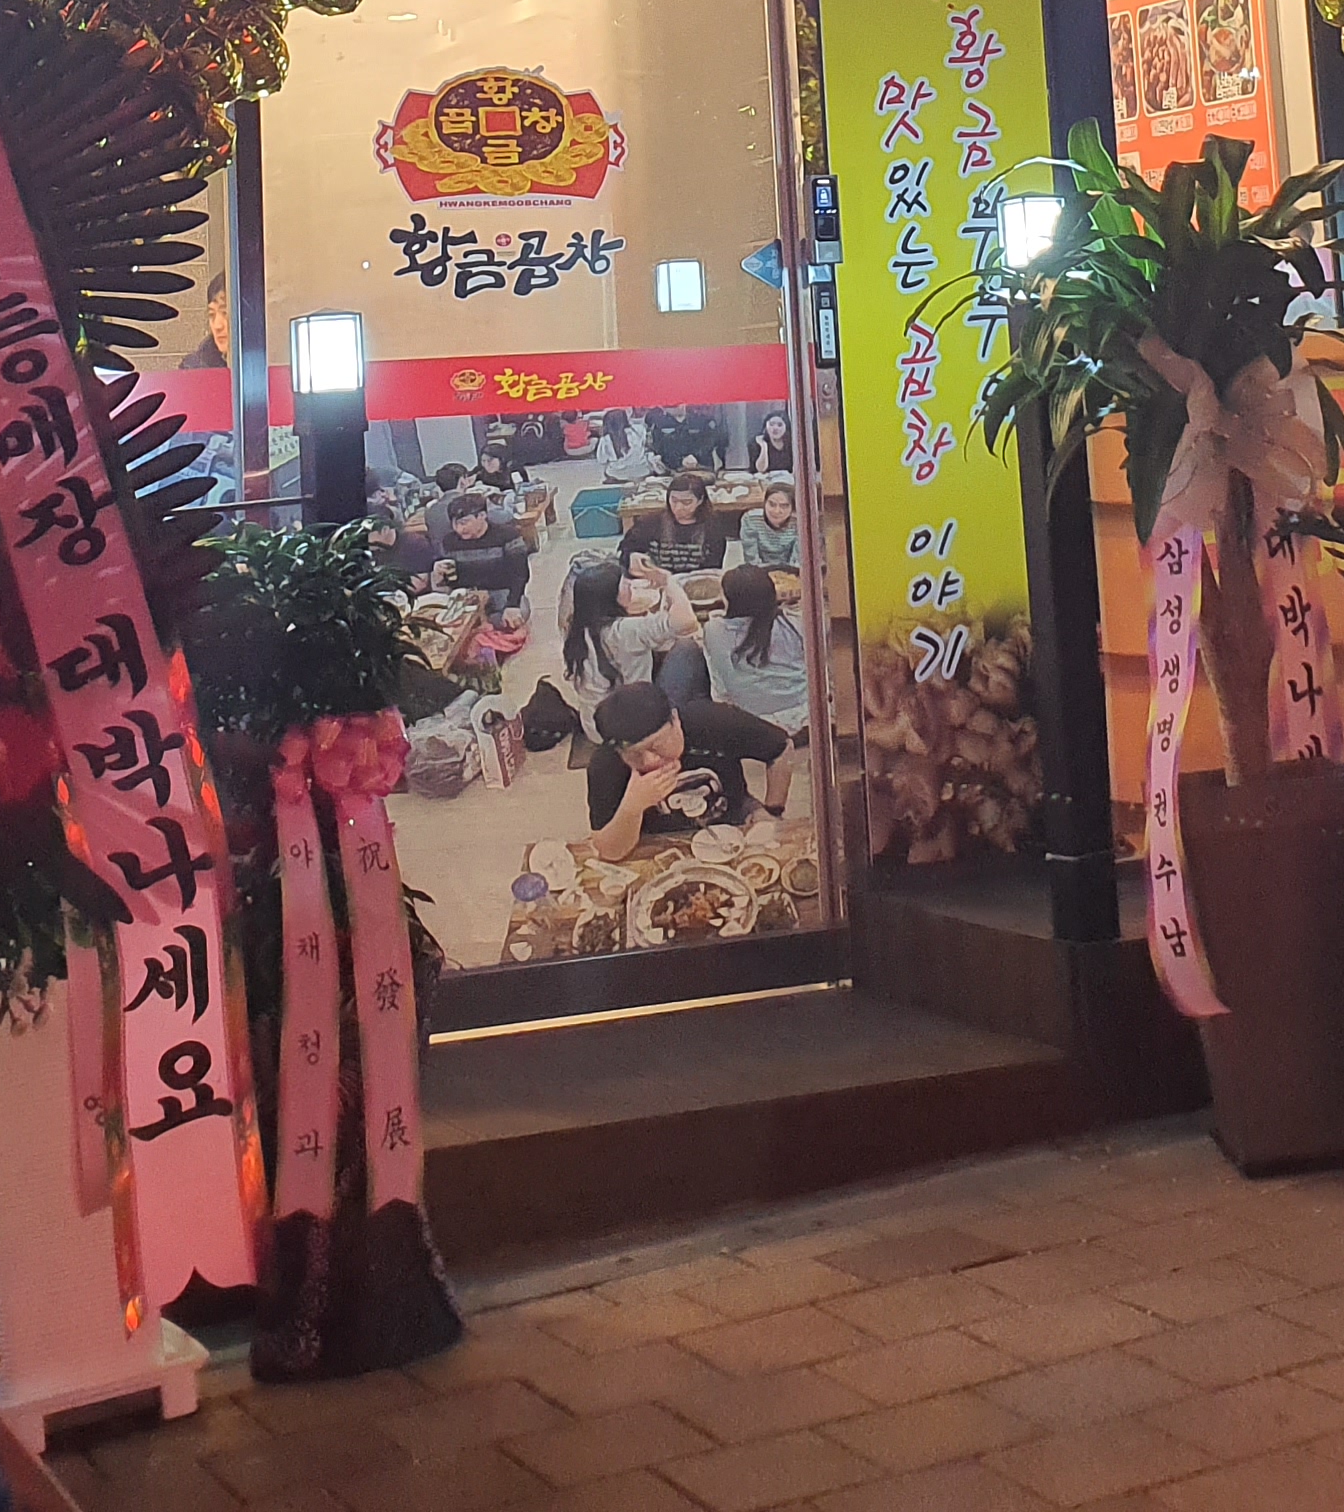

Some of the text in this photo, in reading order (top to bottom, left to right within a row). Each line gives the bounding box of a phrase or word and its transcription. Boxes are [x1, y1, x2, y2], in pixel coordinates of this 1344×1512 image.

[390, 213, 624, 298] 황금곱창
[494, 368, 614, 402] 황금곱창
[878, 74, 964, 683] 맛있는 곱창 이야기
[1156, 538, 1188, 751] 삼성생명
[36, 614, 232, 1144] 대박나세요
[357, 836, 411, 1152] 祝發展
